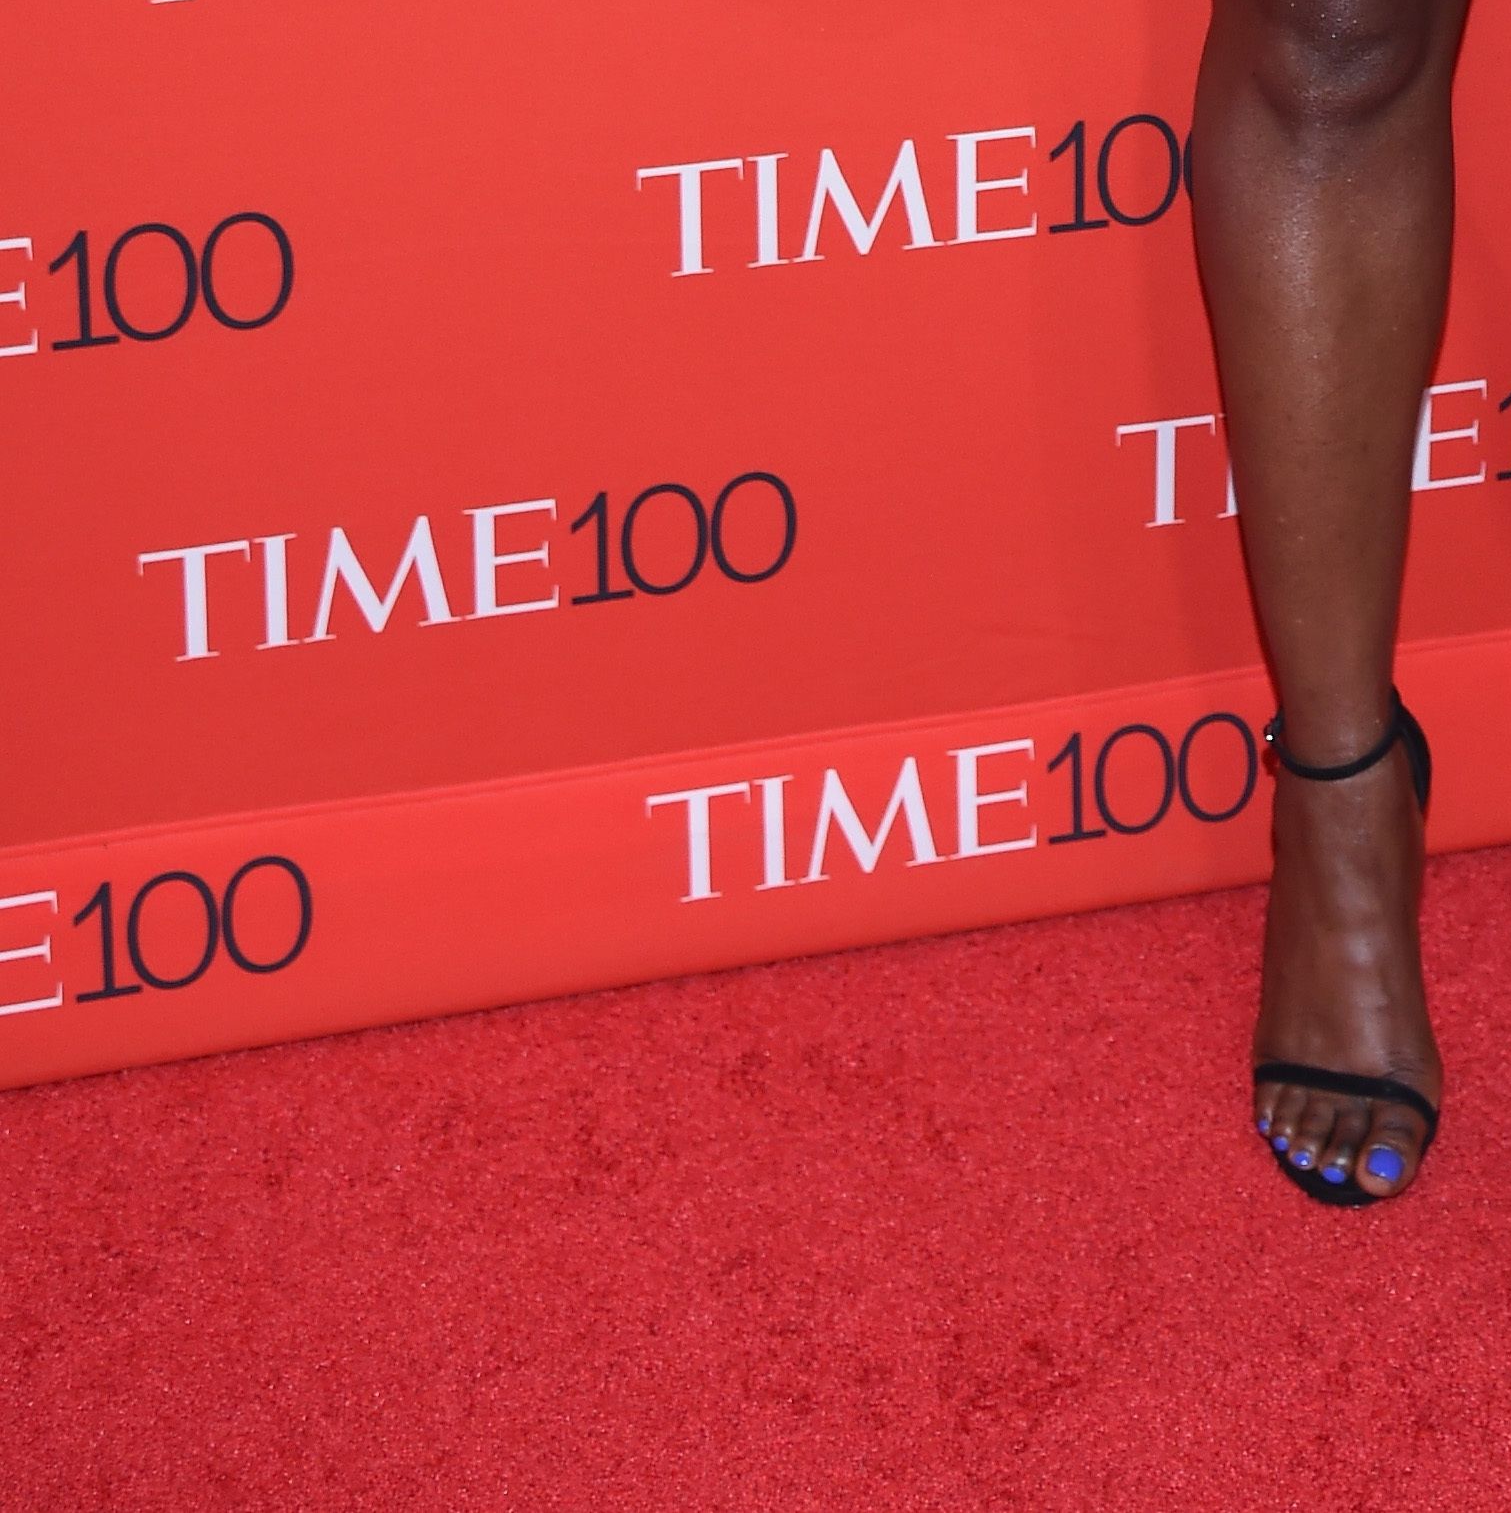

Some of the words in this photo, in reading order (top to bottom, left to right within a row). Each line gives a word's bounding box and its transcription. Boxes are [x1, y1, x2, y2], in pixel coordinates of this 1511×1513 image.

[636, 120, 1192, 277] TIME10
[137, 471, 797, 660] TIME100
[645, 711, 1259, 903] TIME100
